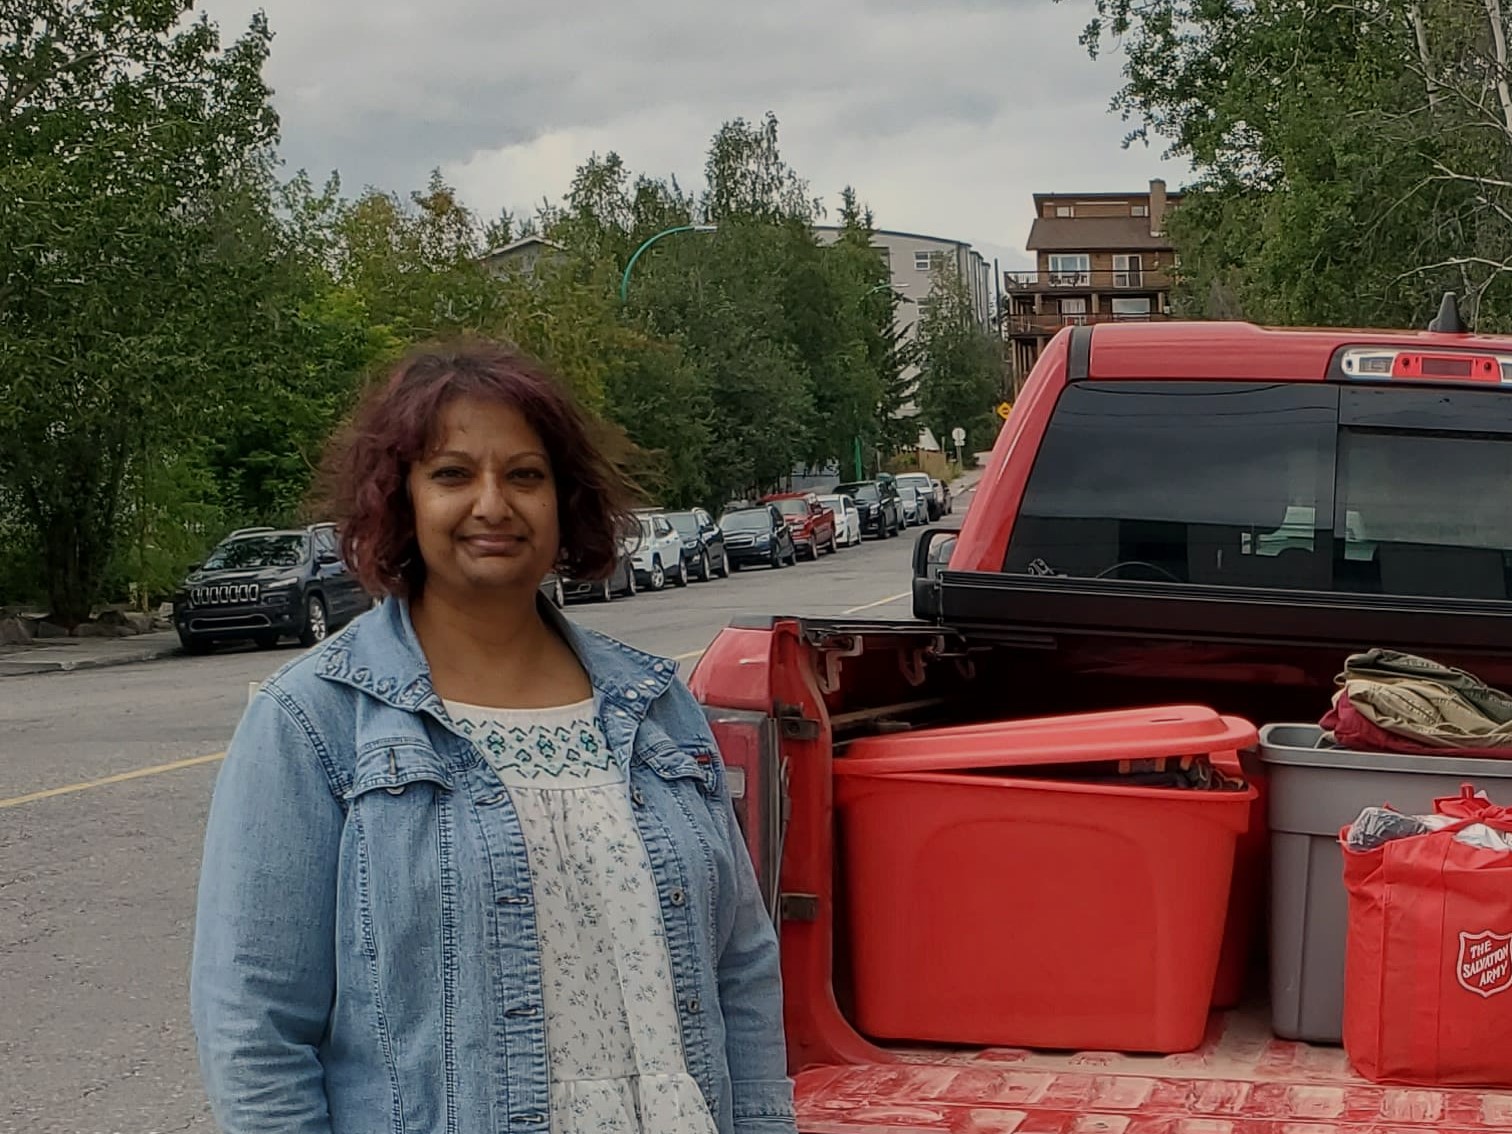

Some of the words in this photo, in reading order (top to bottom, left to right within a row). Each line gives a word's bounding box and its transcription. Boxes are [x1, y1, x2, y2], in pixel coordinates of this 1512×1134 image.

[1462, 943, 1509, 979] SALVATION
[1470, 940, 1493, 959] THE
[1479, 960, 1508, 987] ARMY
